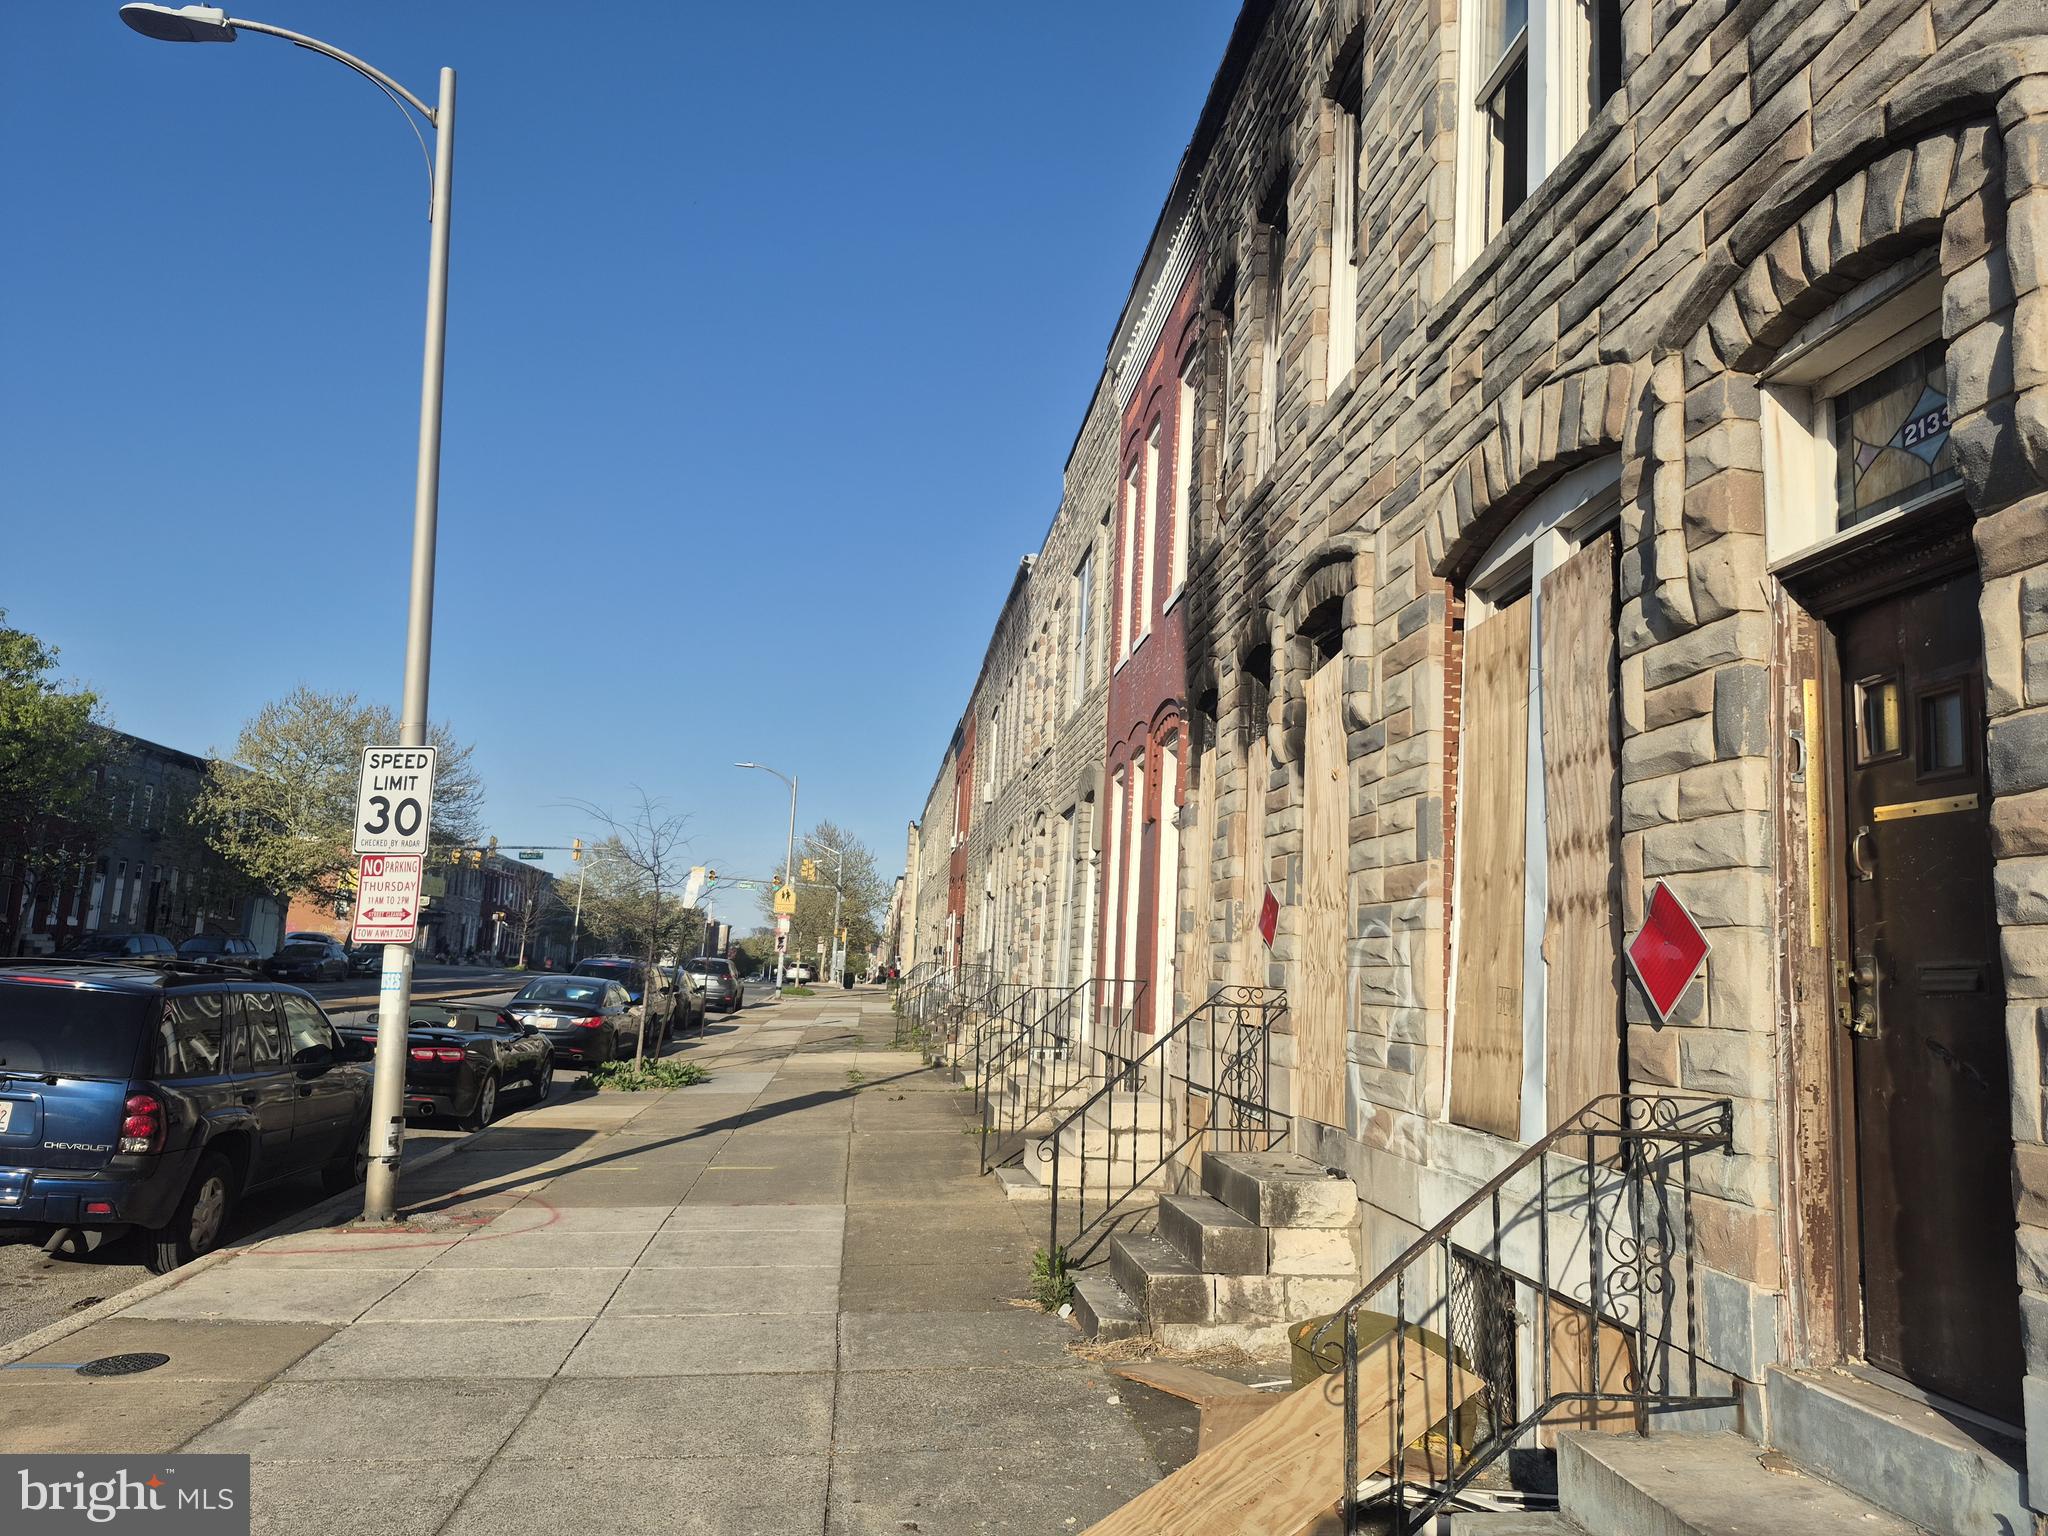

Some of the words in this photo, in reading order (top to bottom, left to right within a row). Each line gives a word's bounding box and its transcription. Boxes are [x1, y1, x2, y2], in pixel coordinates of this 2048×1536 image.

[369, 753, 428, 770] SPEED
[373, 775, 419, 791] LIMIT
[363, 795, 423, 837] 30
[361, 839, 388, 847] CHECKED
[401, 840, 421, 848] RADAR
[363, 858, 383, 876] NO
[384, 860, 418, 873] PARKING
[363, 881, 416, 891] THURSDAY
[386, 896, 395, 905] TO
[357, 928, 373, 937] TOW
[375, 929, 394, 937] AWAY
[395, 929, 412, 937] ZONE
[44, 1141, 112, 1152] CHEVROLET
